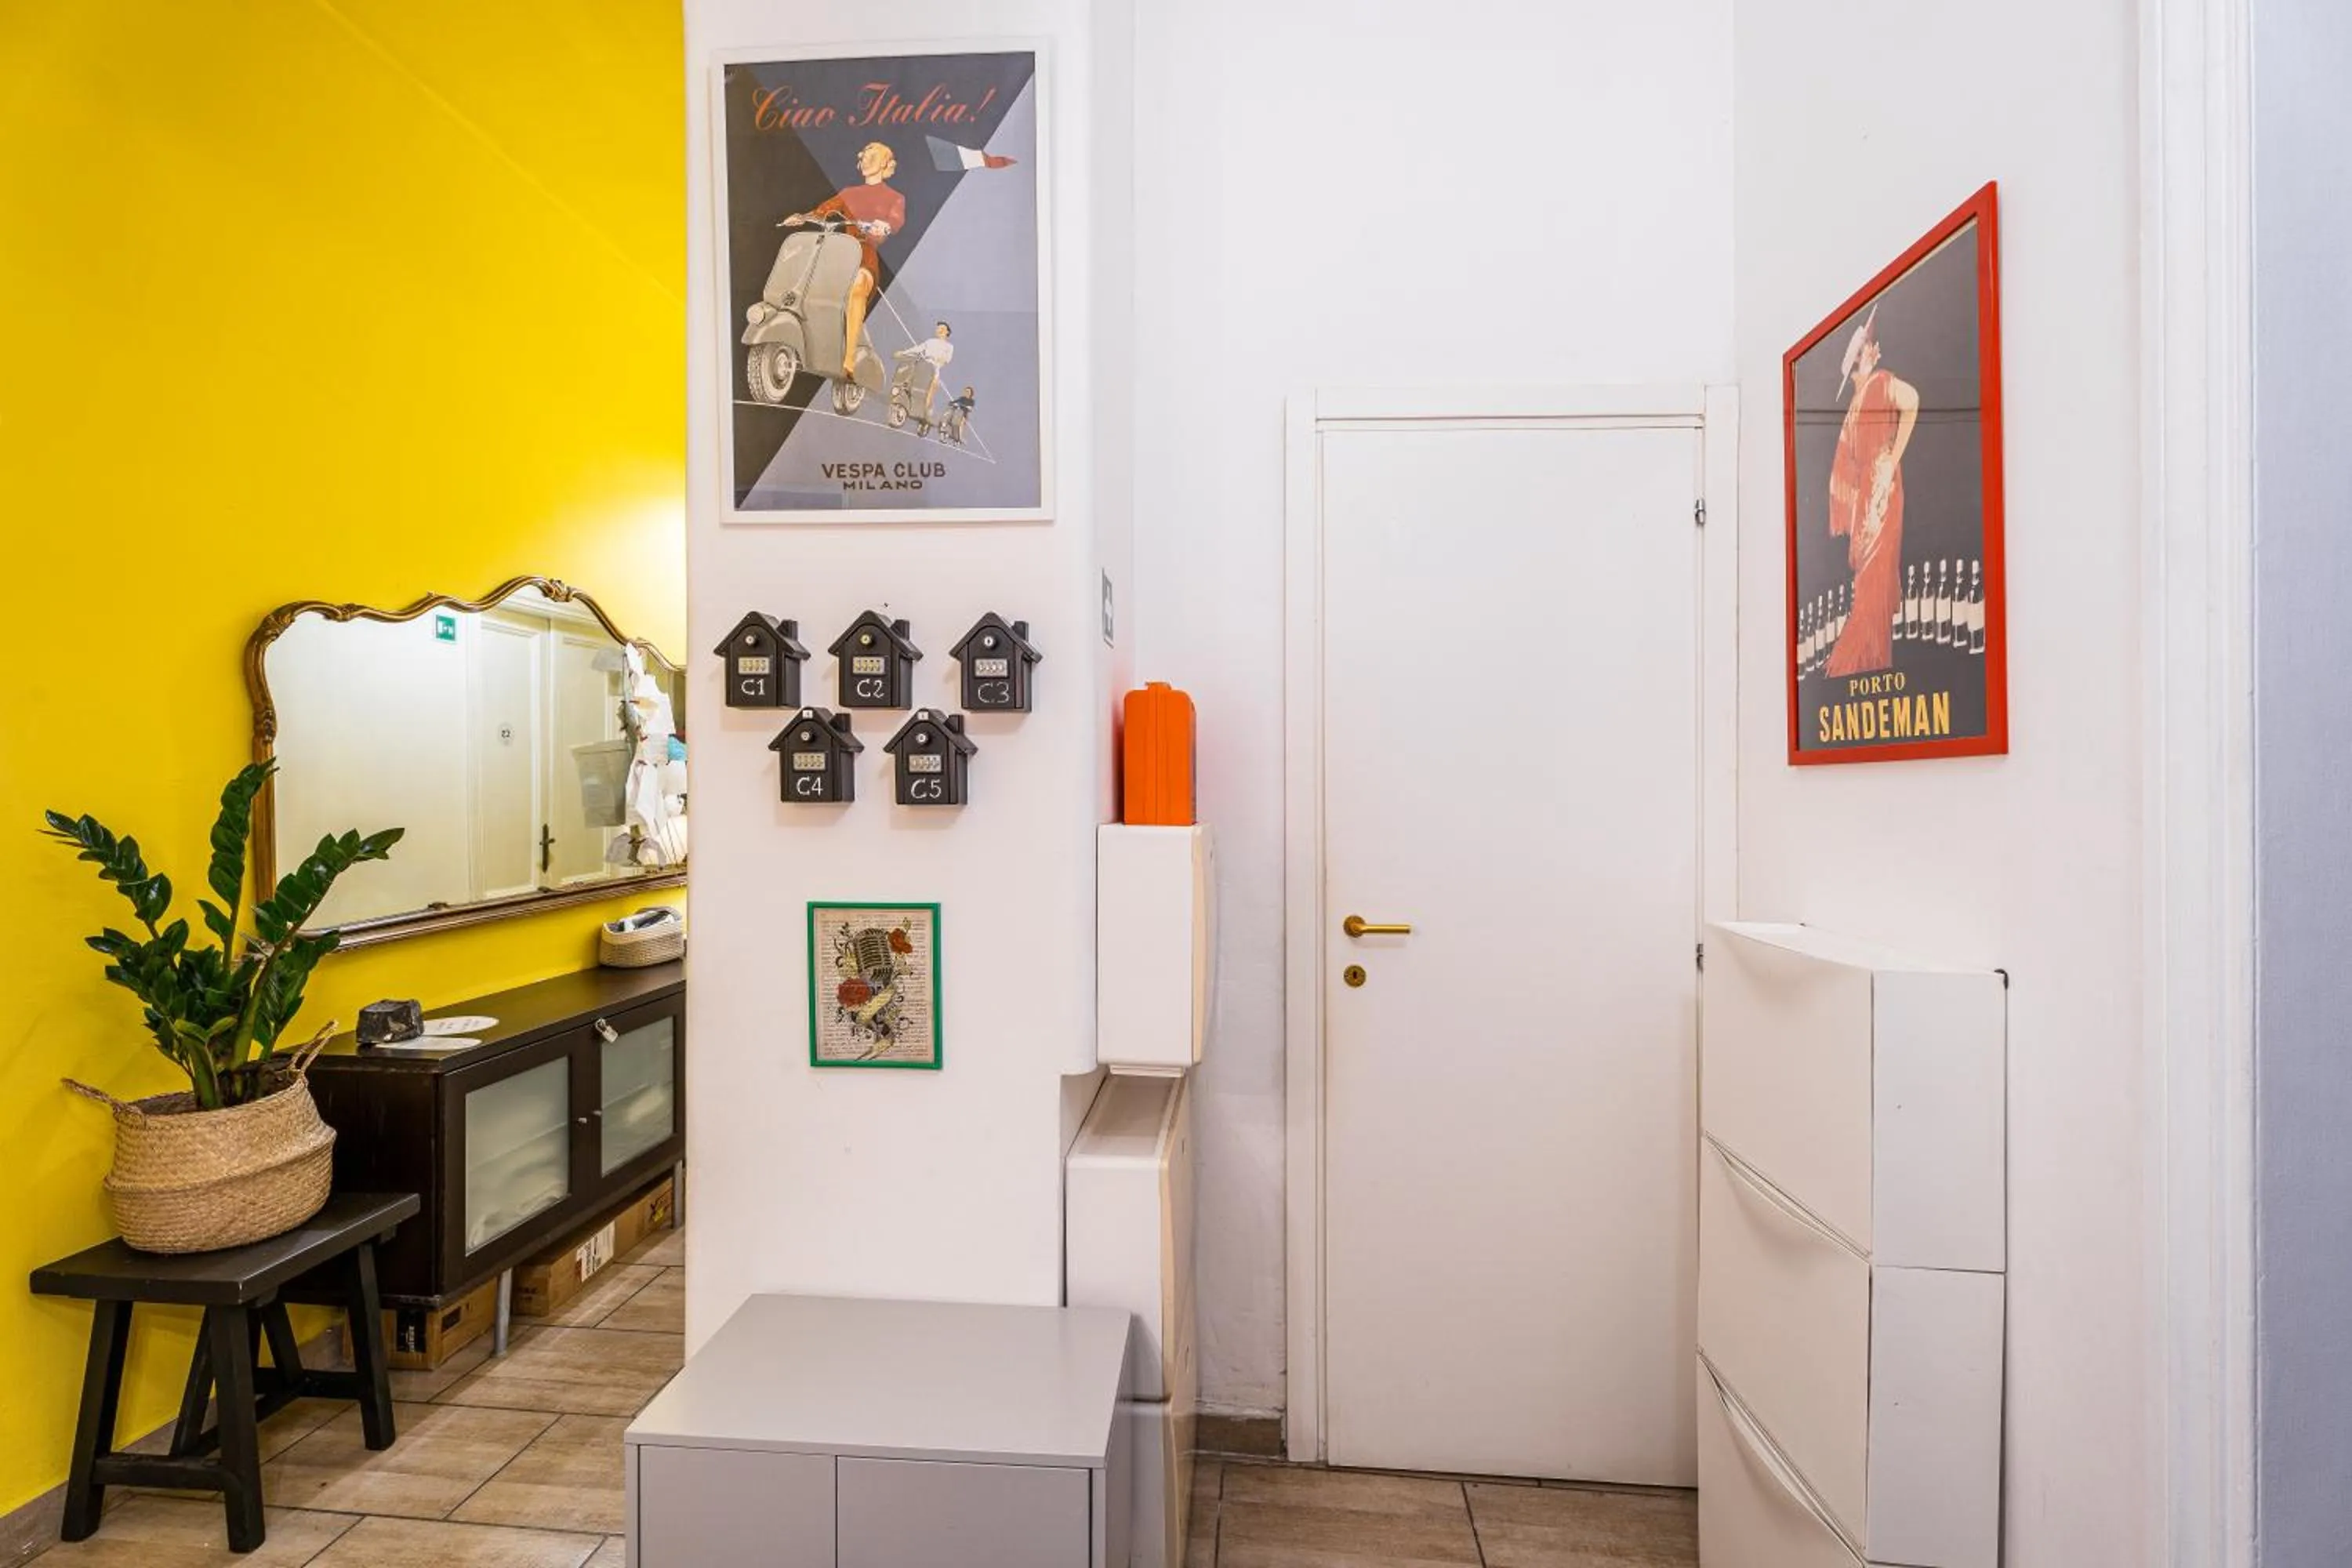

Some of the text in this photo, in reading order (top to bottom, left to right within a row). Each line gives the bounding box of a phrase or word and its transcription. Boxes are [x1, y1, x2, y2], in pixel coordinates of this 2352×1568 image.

[752, 82, 997, 131] Ciao Italia!
[822, 462, 946, 478] VESPA CLUB
[843, 480, 923, 490] MILANO
[741, 679, 766, 696] C1
[857, 678, 884, 698] C2
[978, 681, 1010, 703] C3
[1849, 672, 1906, 696] PORTO
[1819, 691, 1951, 742] SANDEMAN
[796, 776, 823, 796] C4
[910, 778, 942, 798] C5
